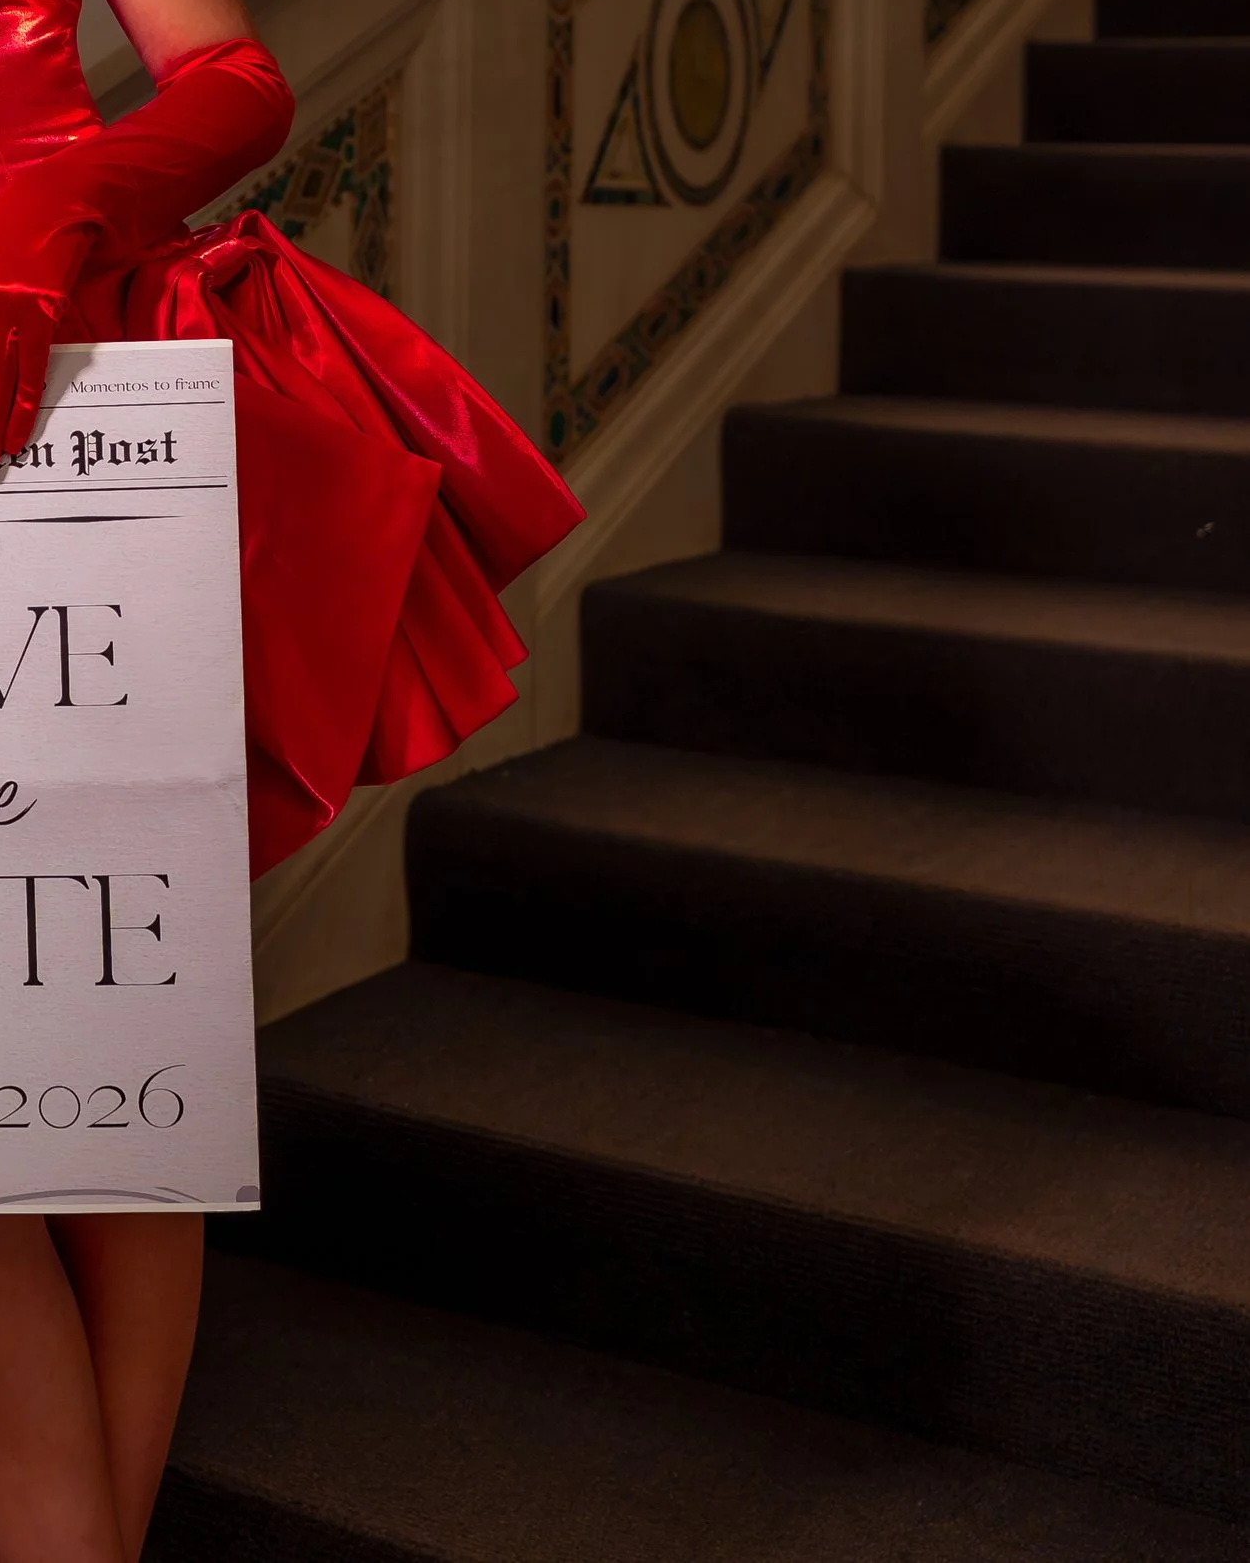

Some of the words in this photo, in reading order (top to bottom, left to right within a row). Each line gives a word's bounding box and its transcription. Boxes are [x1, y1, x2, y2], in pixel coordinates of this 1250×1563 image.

[70, 380, 149, 394] Momentos
[154, 380, 170, 392] to
[175, 377, 220, 390] frame
[69, 429, 179, 477] Post
